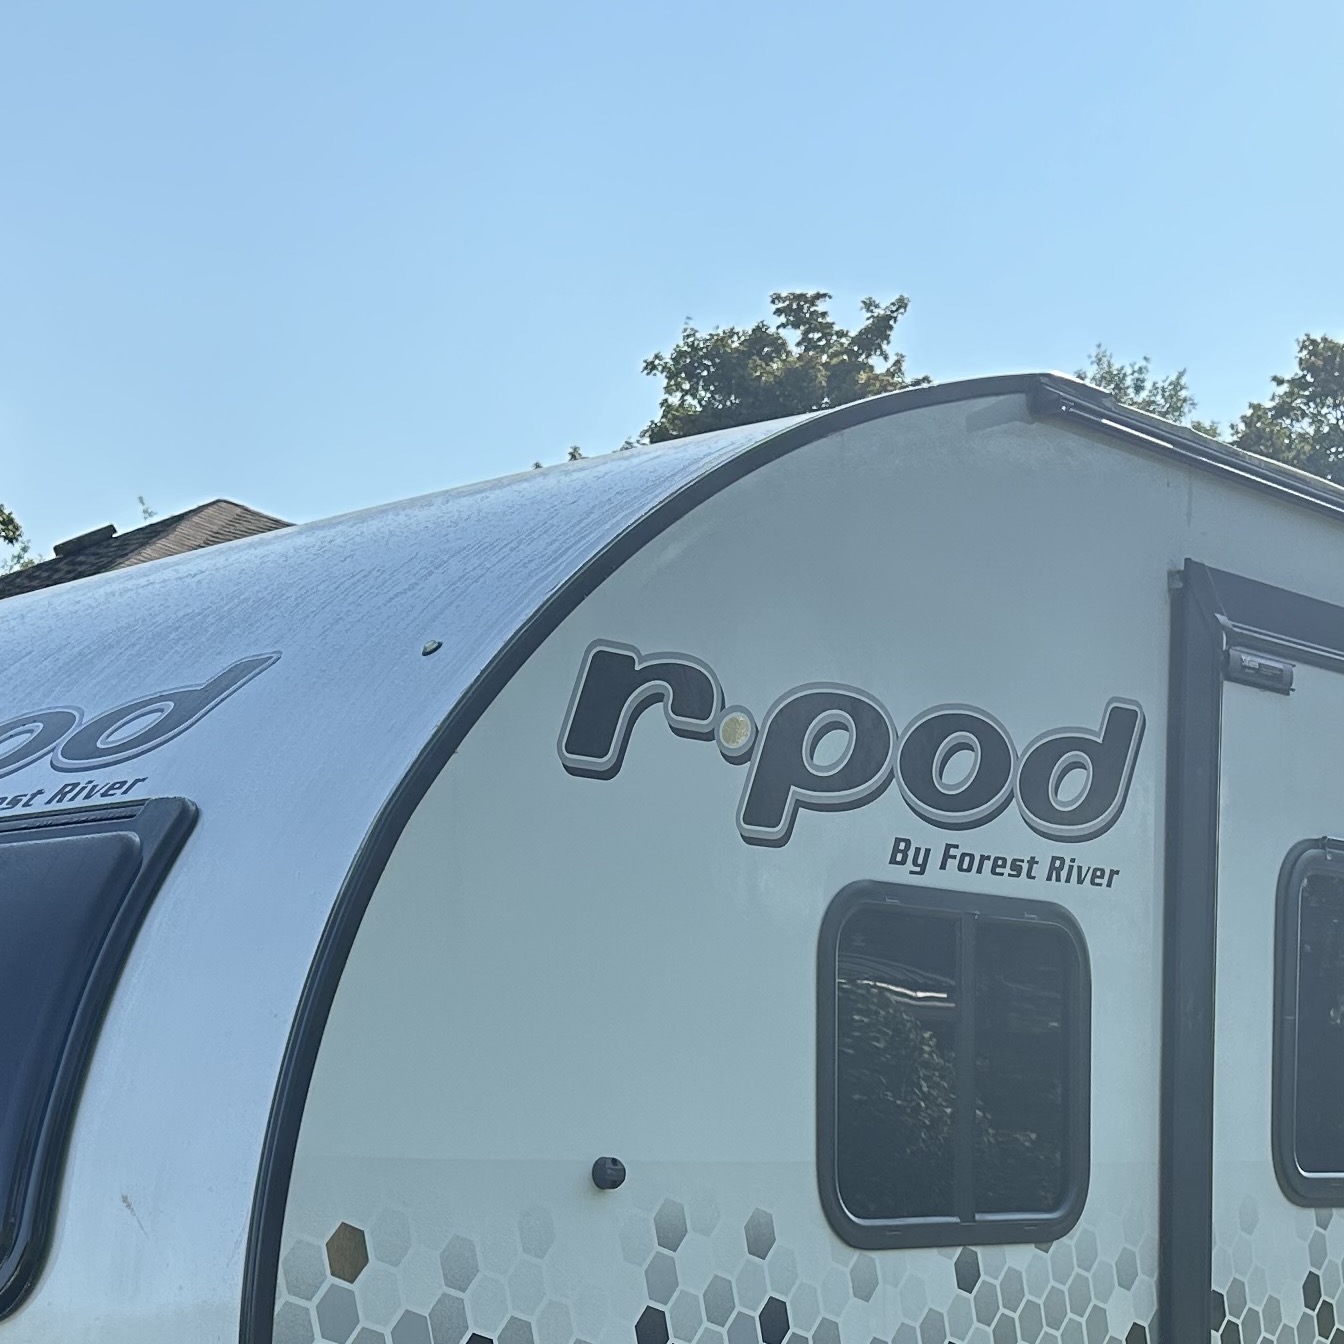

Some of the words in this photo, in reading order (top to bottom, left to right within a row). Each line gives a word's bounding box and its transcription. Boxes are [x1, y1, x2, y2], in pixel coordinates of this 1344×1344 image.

[44, 776, 149, 805] River
[888, 836, 932, 876] By
[938, 842, 1040, 880] Forest
[1045, 855, 1121, 888] River
